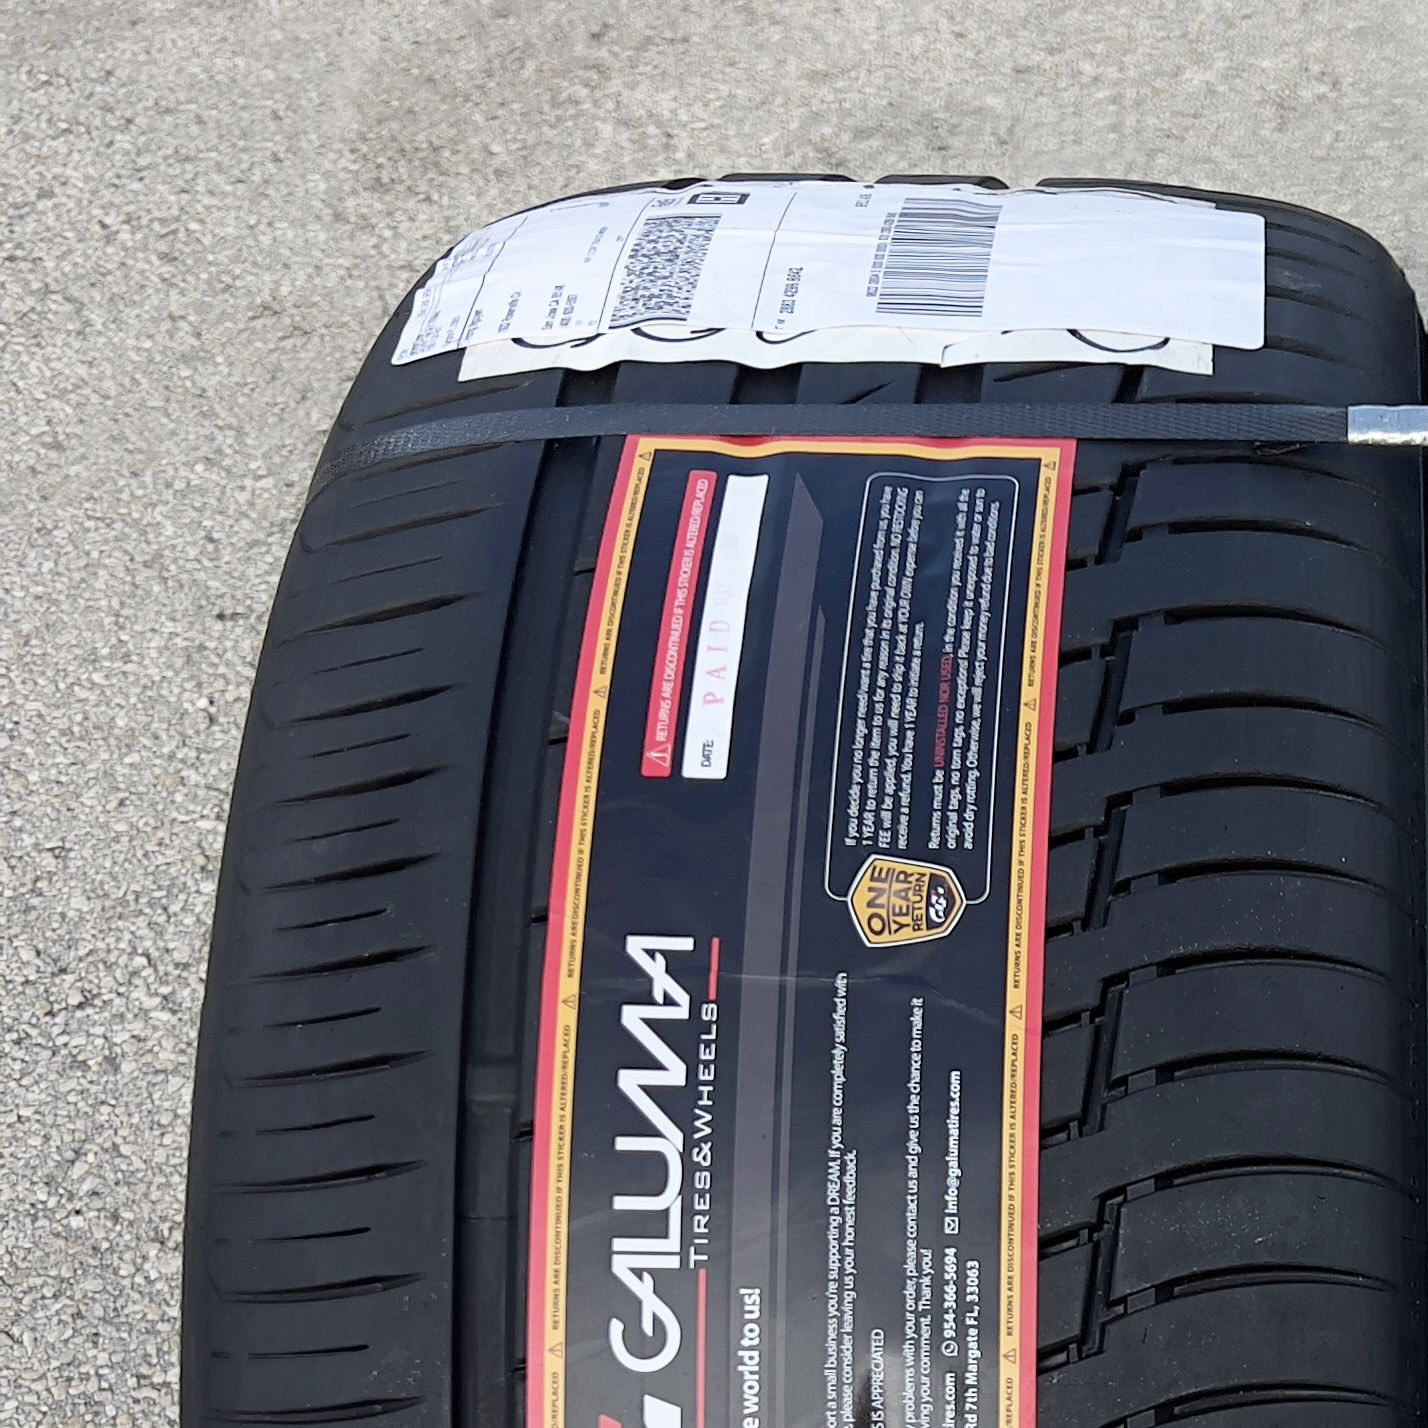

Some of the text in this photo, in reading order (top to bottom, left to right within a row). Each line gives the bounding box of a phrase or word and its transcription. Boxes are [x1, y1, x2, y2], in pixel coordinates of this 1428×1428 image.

[866, 864, 890, 936] ONE
[891, 869, 914, 934] YEAR
[911, 871, 927, 932] RETURN
[834, 972, 848, 997] with
[910, 997, 923, 1007] it
[832, 997, 847, 1043] satisfied
[909, 1006, 923, 1039] make
[909, 1038, 922, 1052] to
[831, 1043, 848, 1107] completely
[908, 1052, 922, 1094] chance
[832, 1106, 843, 1126] are
[907, 1093, 921, 1114] the
[909, 1114, 920, 1129] us
[608, 933, 695, 1373] GALUMA
[688, 1001, 718, 1269] TIRES&WHEELS
[832, 1126, 845, 1149] you
[906, 1129, 922, 1155] give
[944, 1070, 964, 1214] info@galumatires.com
[829, 1149, 842, 1159] If
[906, 1154, 919, 1179] and
[827, 1158, 842, 1205] DREAM.
[843, 1149, 857, 1205] feedback.
[908, 1179, 918, 1193] us
[830, 1206, 840, 1215] a
[842, 1205, 856, 1246] honest
[905, 1194, 918, 1238] contact
[826, 1215, 843, 1280] supporting
[844, 1247, 858, 1274] your
[904, 1238, 920, 1277] please
[920, 1248, 936, 1275] you!
[826, 1280, 842, 1317] you're
[844, 1275, 855, 1289] us
[919, 1275, 933, 1312] Thank
[944, 1247, 958, 1339] 954-366-5694
[965, 1260, 979, 1303] 33063
[738, 1288, 760, 1320] us!
[841, 1290, 857, 1333] leaving
[965, 1305, 982, 1325] FL,
[738, 1322, 760, 1348] to
[825, 1318, 839, 1368] business
[906, 1311, 919, 1339] your
[841, 1333, 854, 1384] consider
[903, 1340, 916, 1366] with
[919, 1314, 932, 1374] comment.
[965, 1327, 982, 1385] Margate
[738, 1350, 761, 1415] world
[825, 1369, 838, 1400] small
[871, 1328, 885, 1410] APPRECIATED
[828, 1401, 838, 1409] a
[841, 1384, 857, 1423] please
[903, 1367, 918, 1423] problems
[921, 1375, 934, 1403] your
[965, 1387, 979, 1411] 7th
[871, 1410, 885, 1423] IS
